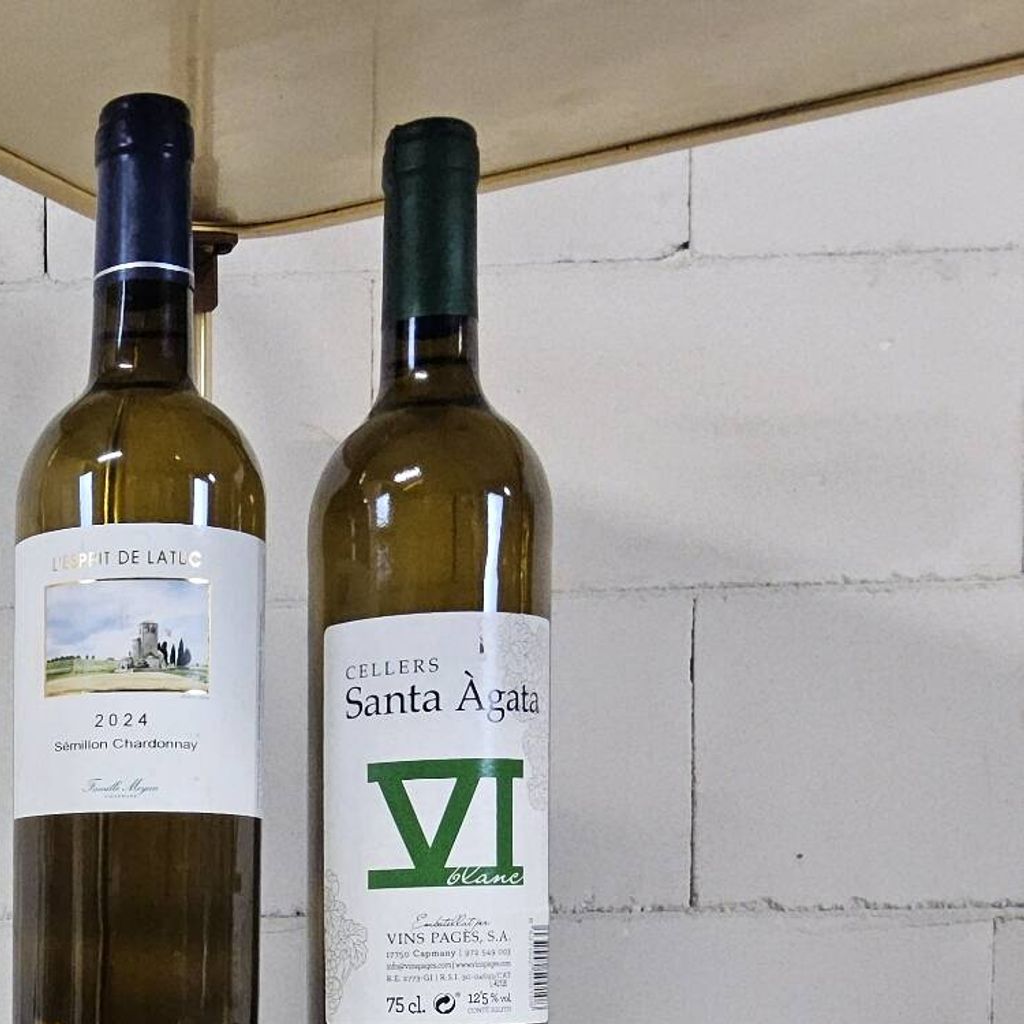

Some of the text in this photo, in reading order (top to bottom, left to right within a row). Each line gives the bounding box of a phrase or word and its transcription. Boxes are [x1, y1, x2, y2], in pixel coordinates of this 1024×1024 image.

[118, 550, 140, 565] DE
[345, 657, 440, 680] CELLERS
[345, 670, 540, 723] Santa Àgata
[94, 712, 148, 728] 2024
[54, 737, 198, 752] Sémillon Chardonnay
[367, 758, 524, 890] VI
[446, 866, 524, 886] blanc
[386, 931, 426, 945] VINS
[412, 948, 456, 959] Capmany
[386, 995, 426, 1014] 75 cl.
